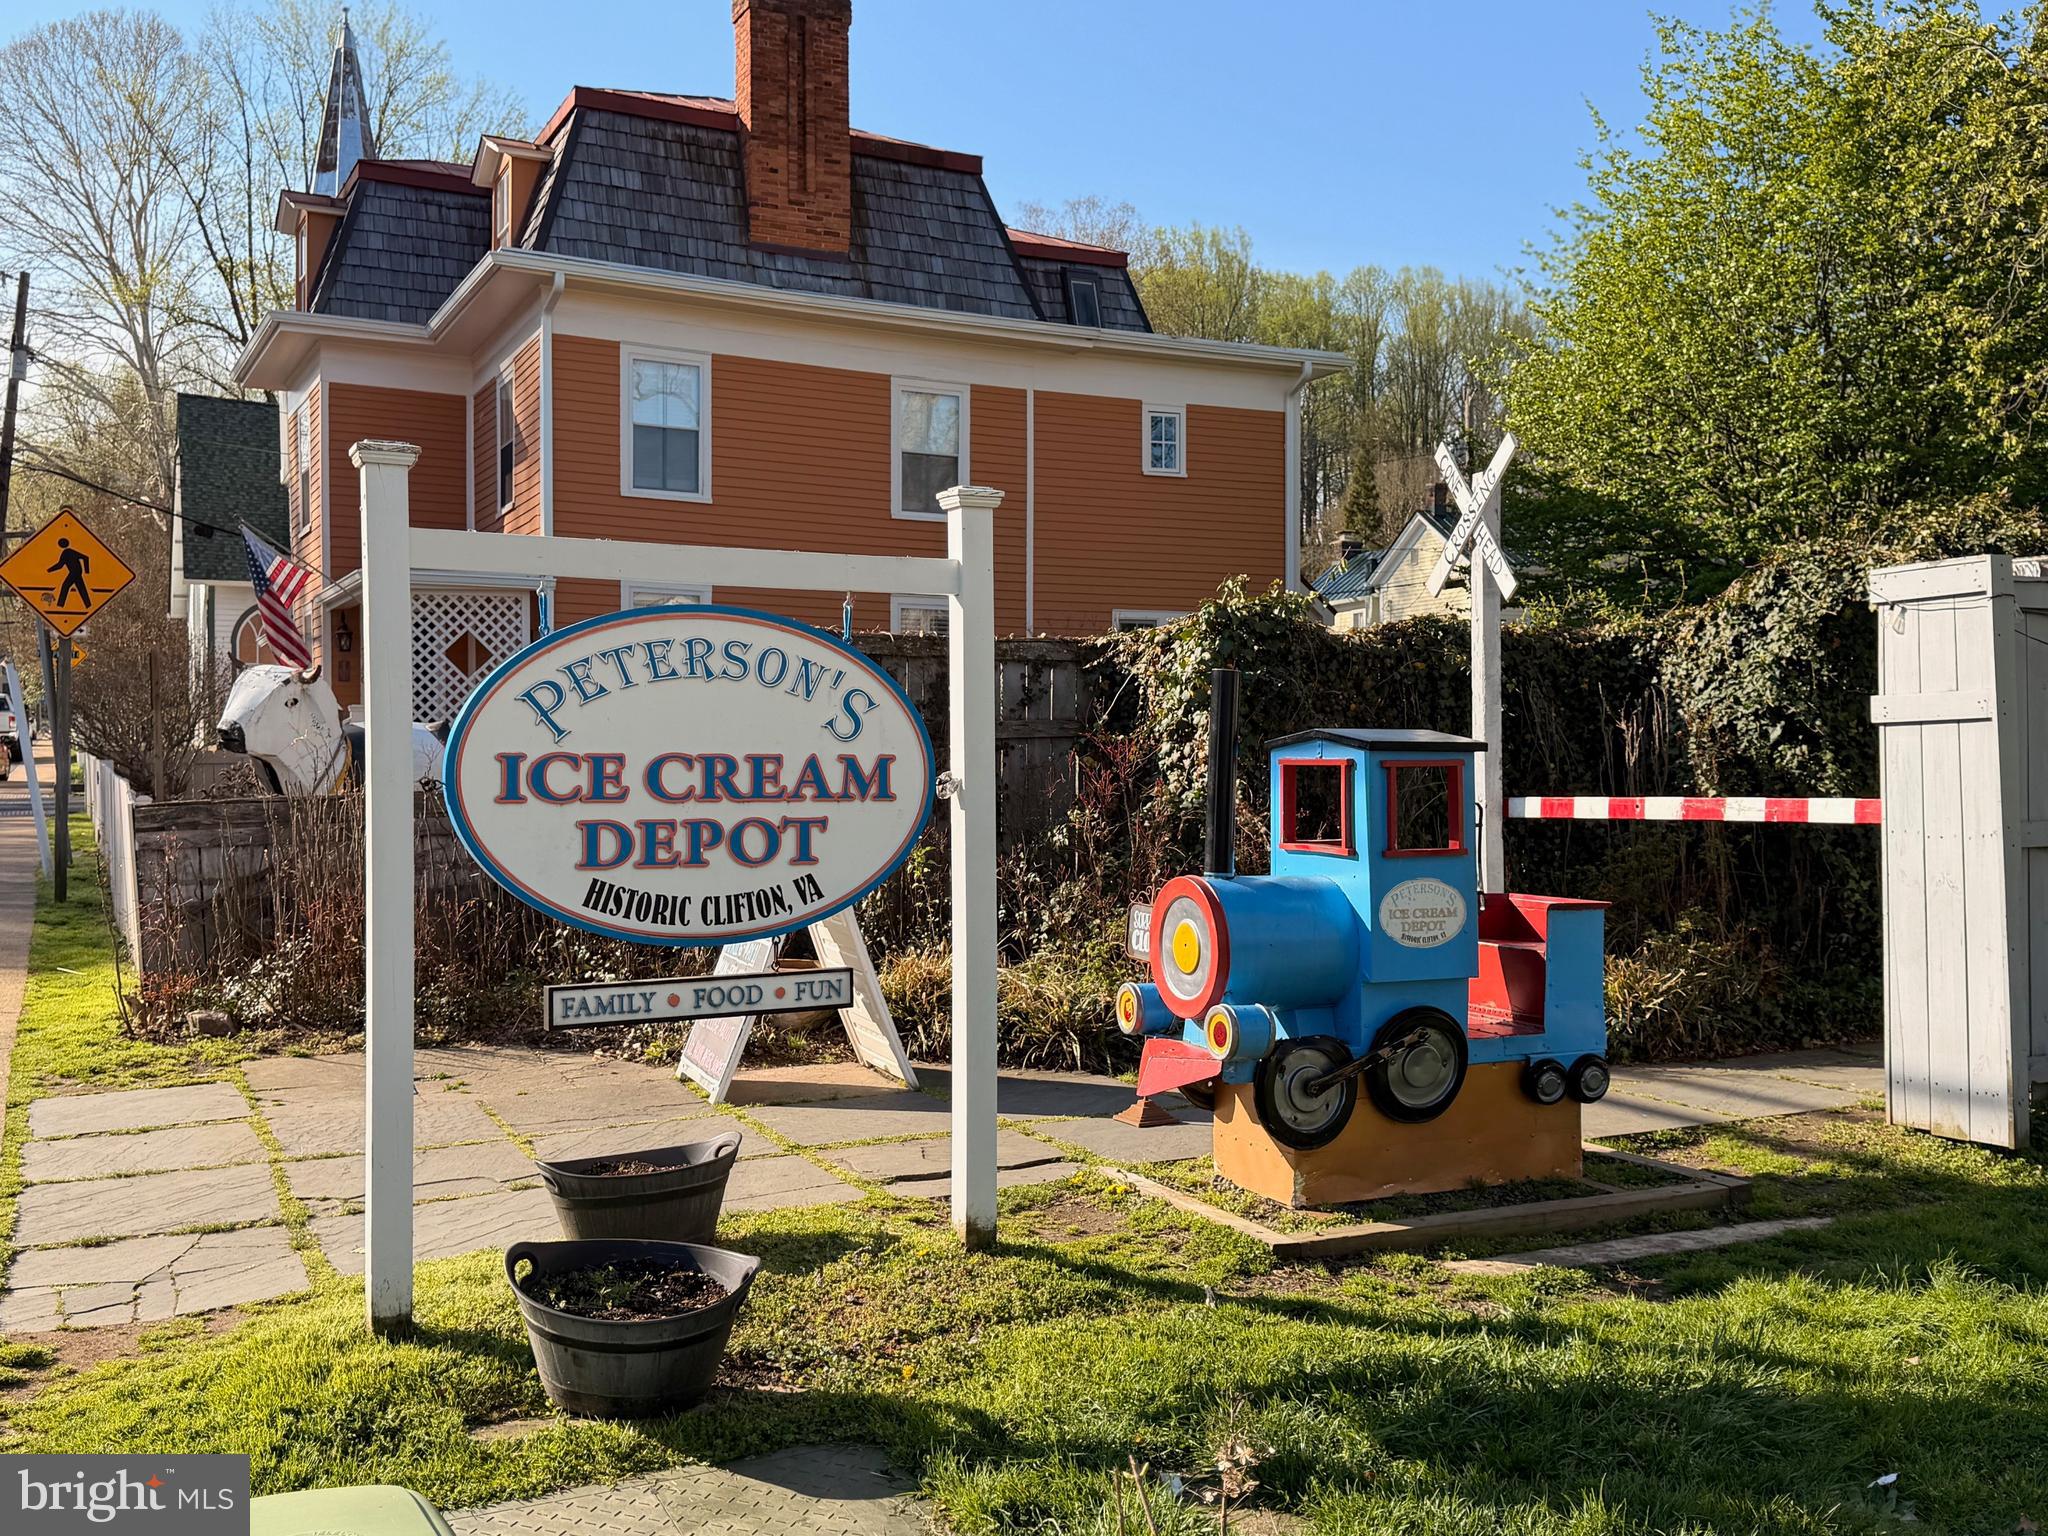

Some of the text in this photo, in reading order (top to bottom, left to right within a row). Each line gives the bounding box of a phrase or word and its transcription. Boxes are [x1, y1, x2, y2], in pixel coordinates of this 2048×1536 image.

[1444, 468, 1496, 565] CROSSING
[1475, 525, 1503, 575] HEAD
[515, 637, 880, 743] PETERSON'S
[494, 752, 898, 804] ICE CREAM
[575, 815, 829, 870] DEPOT
[582, 873, 826, 927] HISTORIC CLIFTON, VA
[1134, 910, 1152, 930] SORR
[1388, 907, 1459, 920] ICE CREAM
[1401, 920, 1447, 932] DEPOT
[561, 978, 843, 1018] FAMILY FOOD FUN
